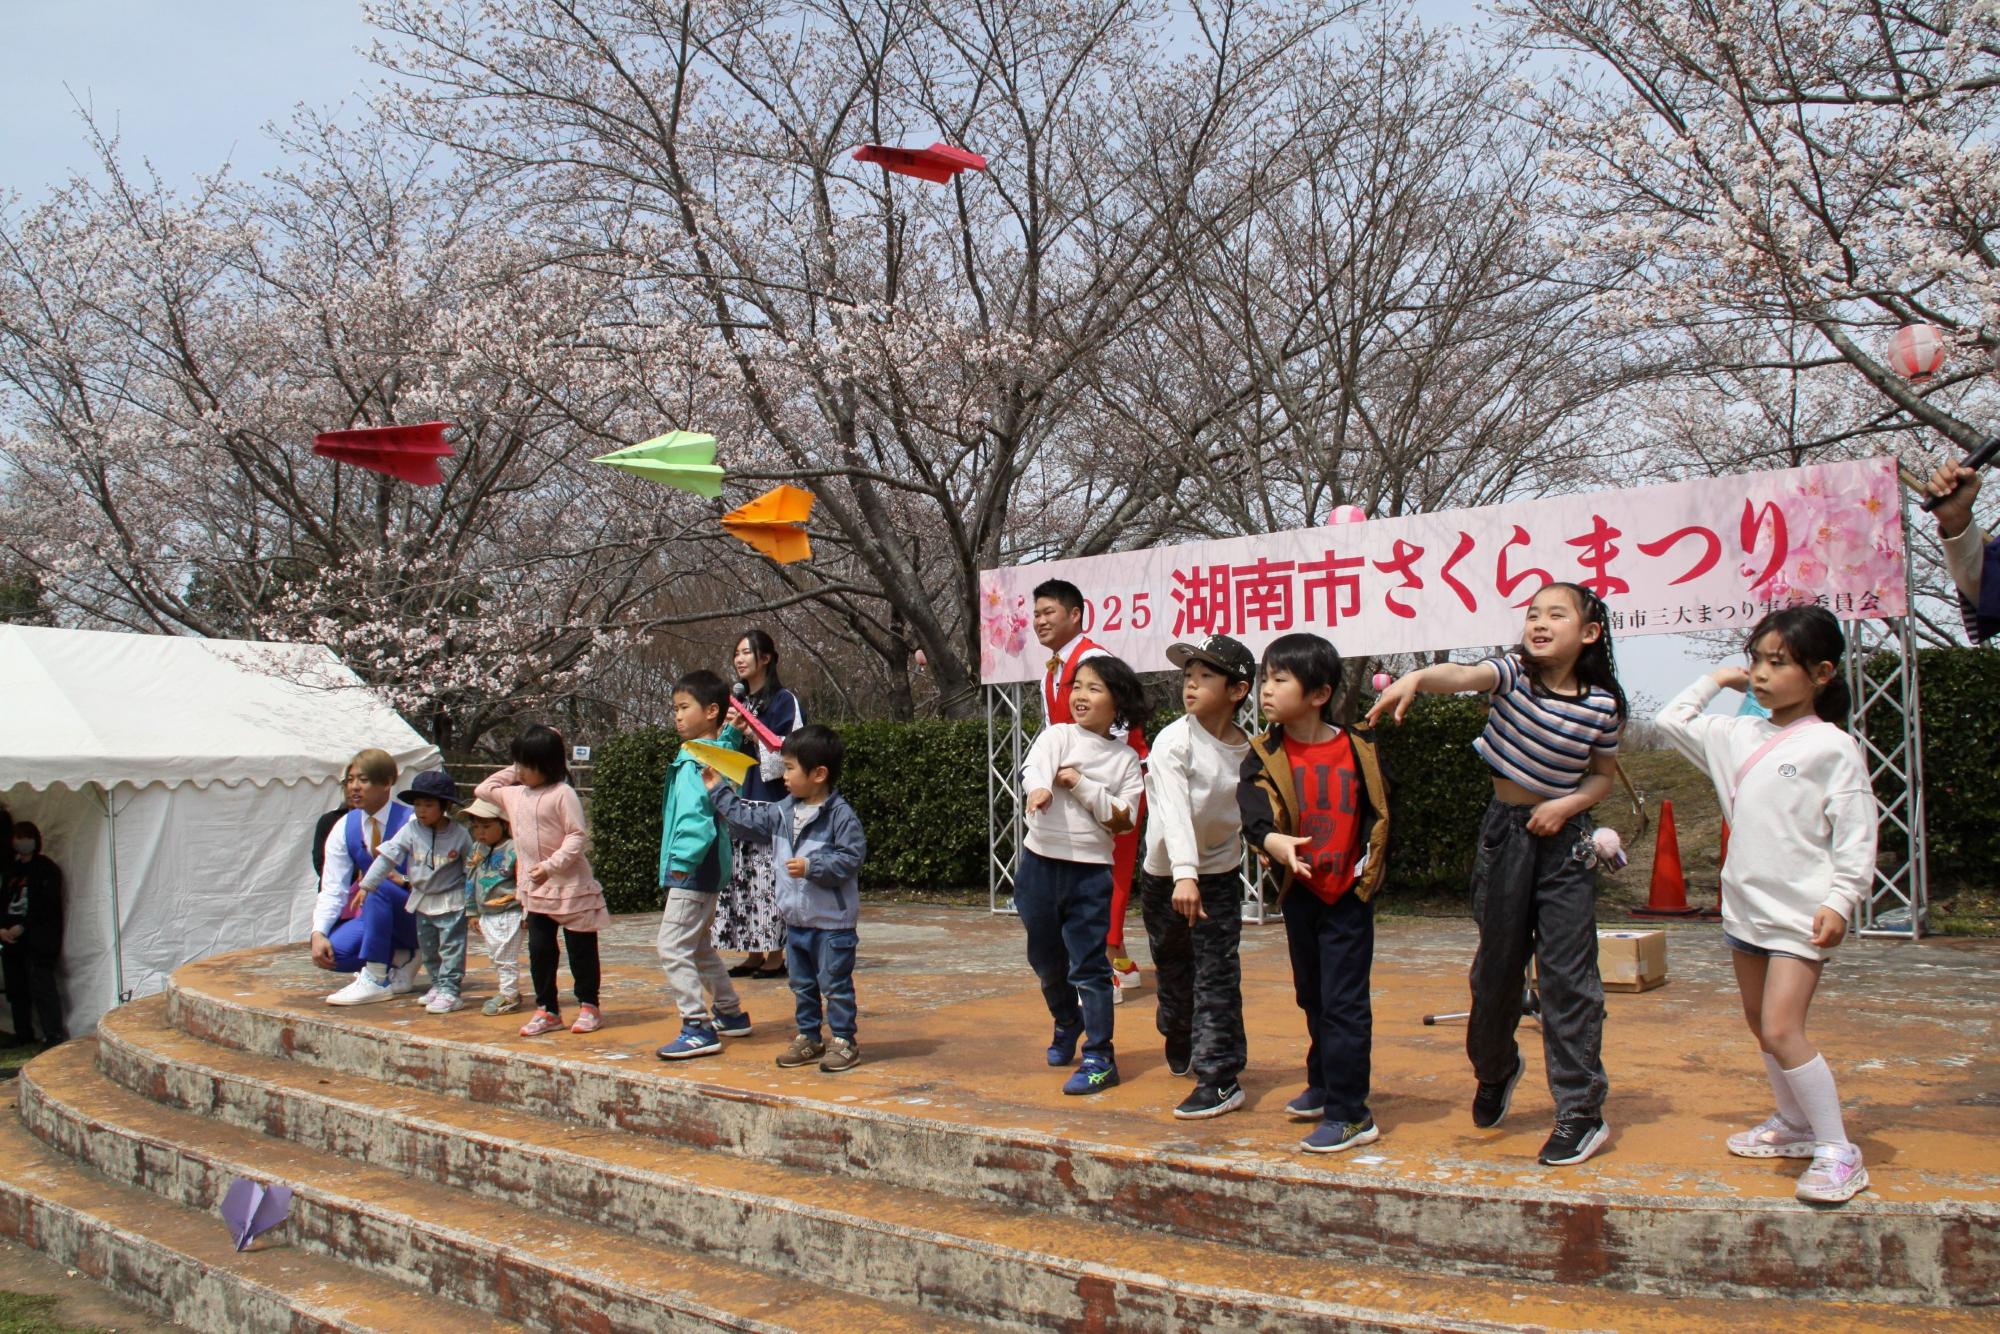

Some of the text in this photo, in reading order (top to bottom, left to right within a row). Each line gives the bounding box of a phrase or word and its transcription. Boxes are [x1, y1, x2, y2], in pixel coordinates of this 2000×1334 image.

[1081, 497, 1788, 638] 025 湖南市さくらまつり
